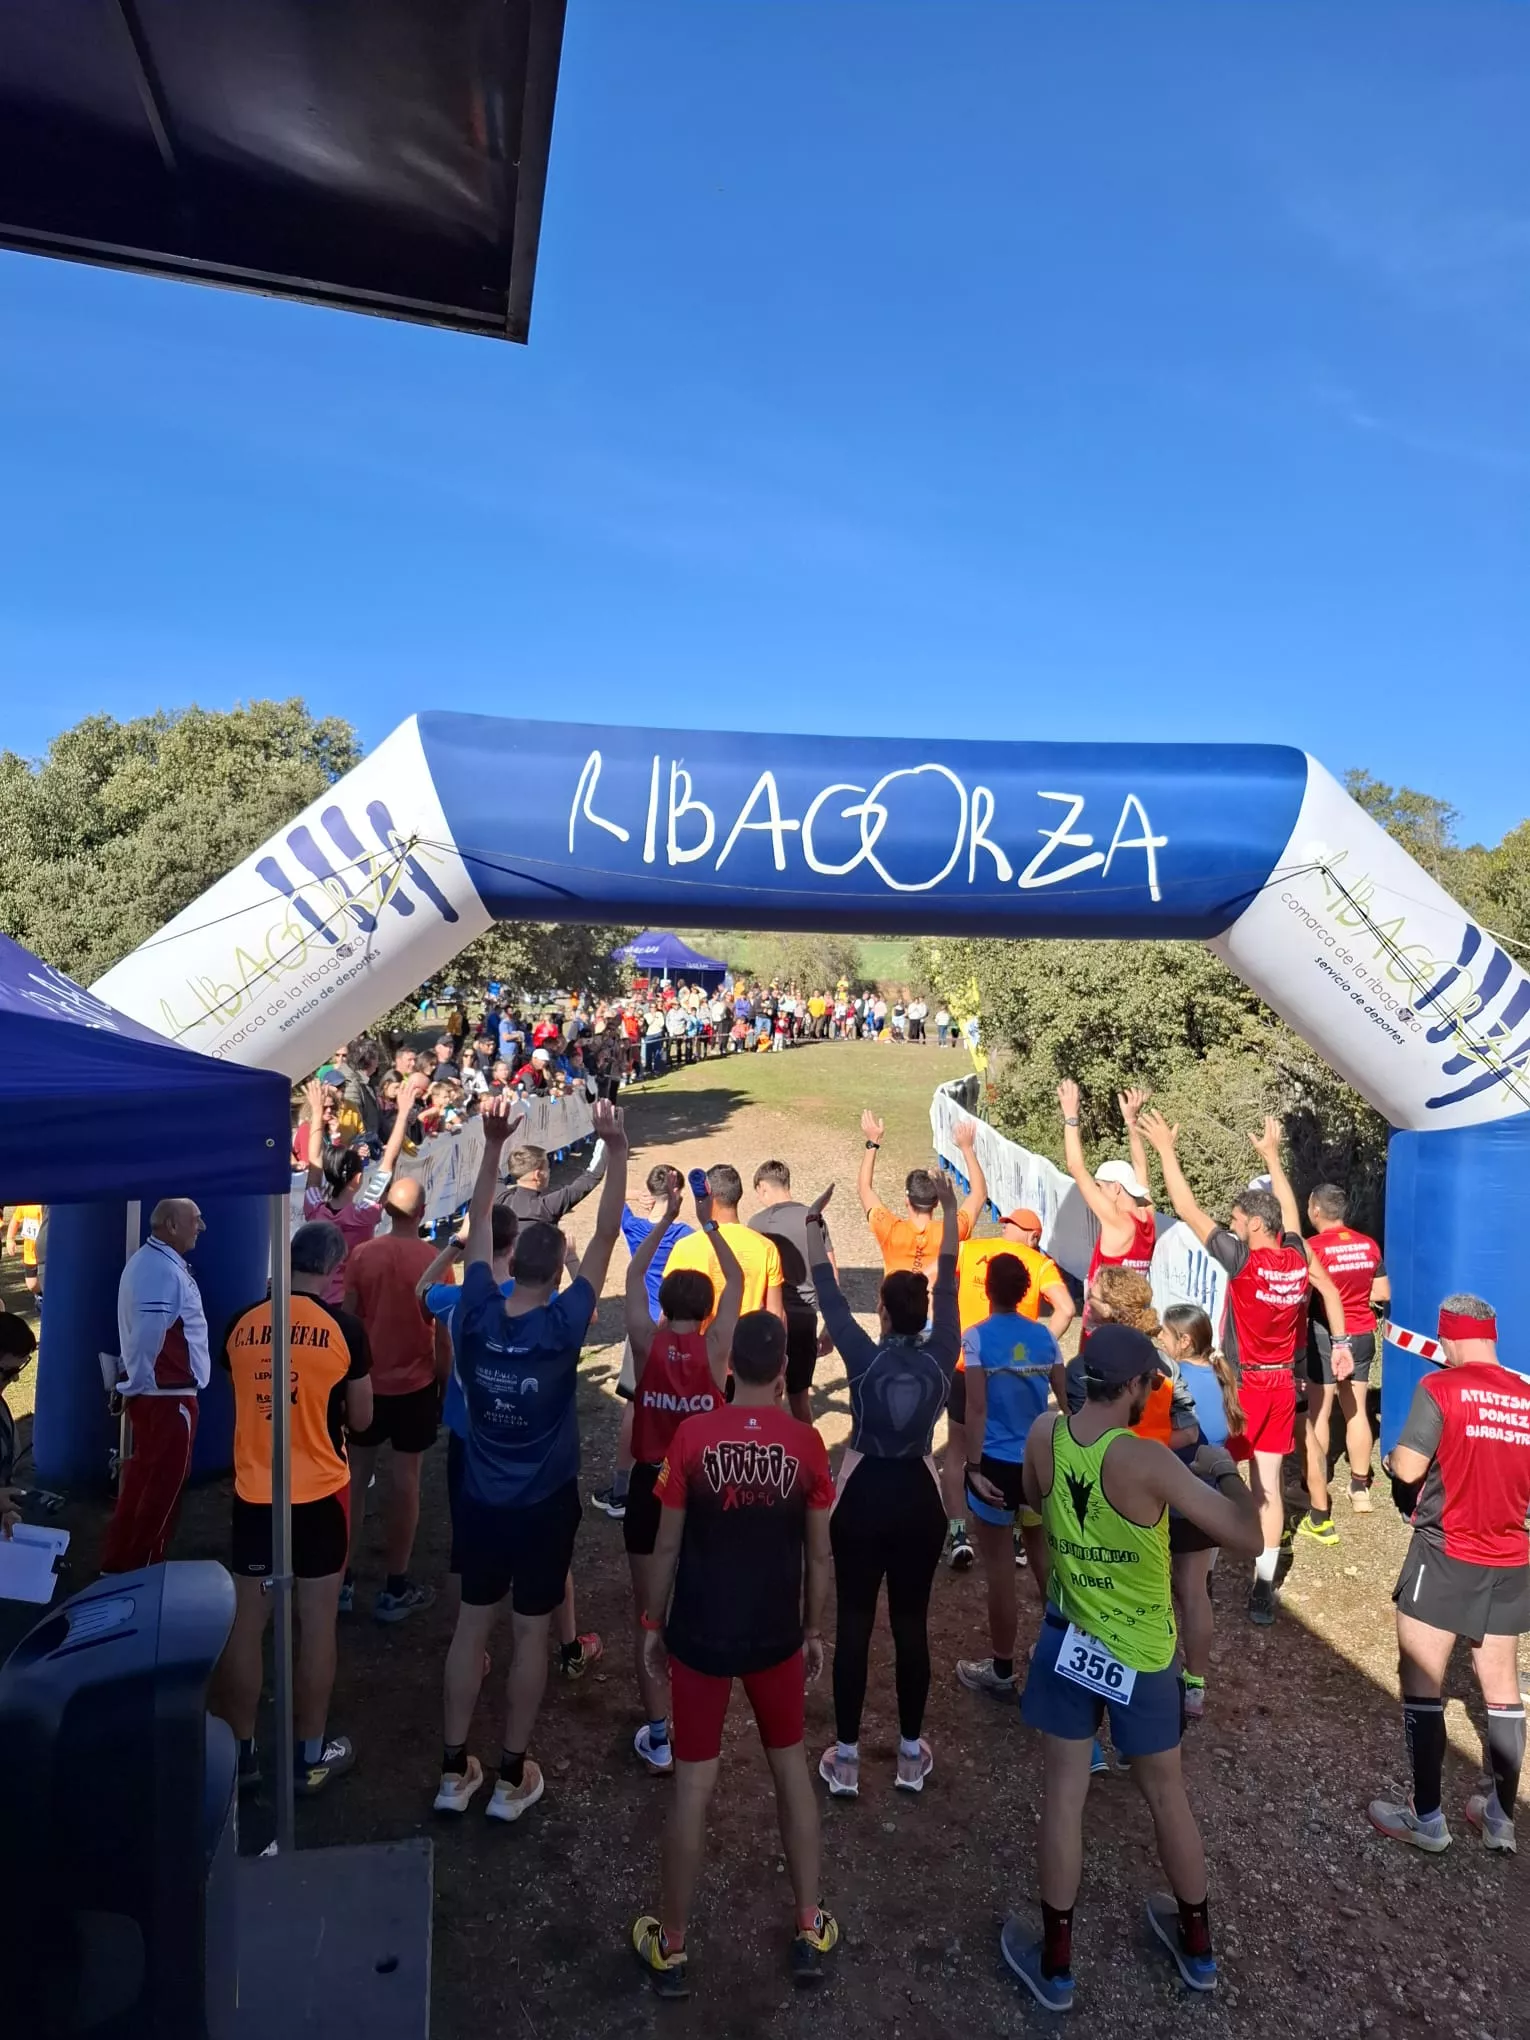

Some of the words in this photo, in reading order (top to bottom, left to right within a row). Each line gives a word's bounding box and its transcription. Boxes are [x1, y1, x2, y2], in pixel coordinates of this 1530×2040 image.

[569, 751, 1169, 901] RIBAGORZA
[1281, 892, 1337, 949] comarca
[1334, 944, 1355, 966] de
[1351, 962, 1368, 983] la
[211, 1014, 266, 1060] omarca
[266, 998, 287, 1017] de
[284, 981, 303, 1000] la
[277, 997, 319, 1034] servicio
[319, 983, 337, 1001] de
[335, 947, 382, 989] deportes
[1314, 955, 1352, 993] servicio
[1350, 990, 1366, 1006] de
[1363, 1004, 1406, 1046] deportes
[1460, 1388, 1530, 1411] ATLETISM
[1465, 1424, 1530, 1446] BARBASTR
[1070, 1572, 1115, 1590] ROBER
[1069, 1646, 1125, 1689] 356
